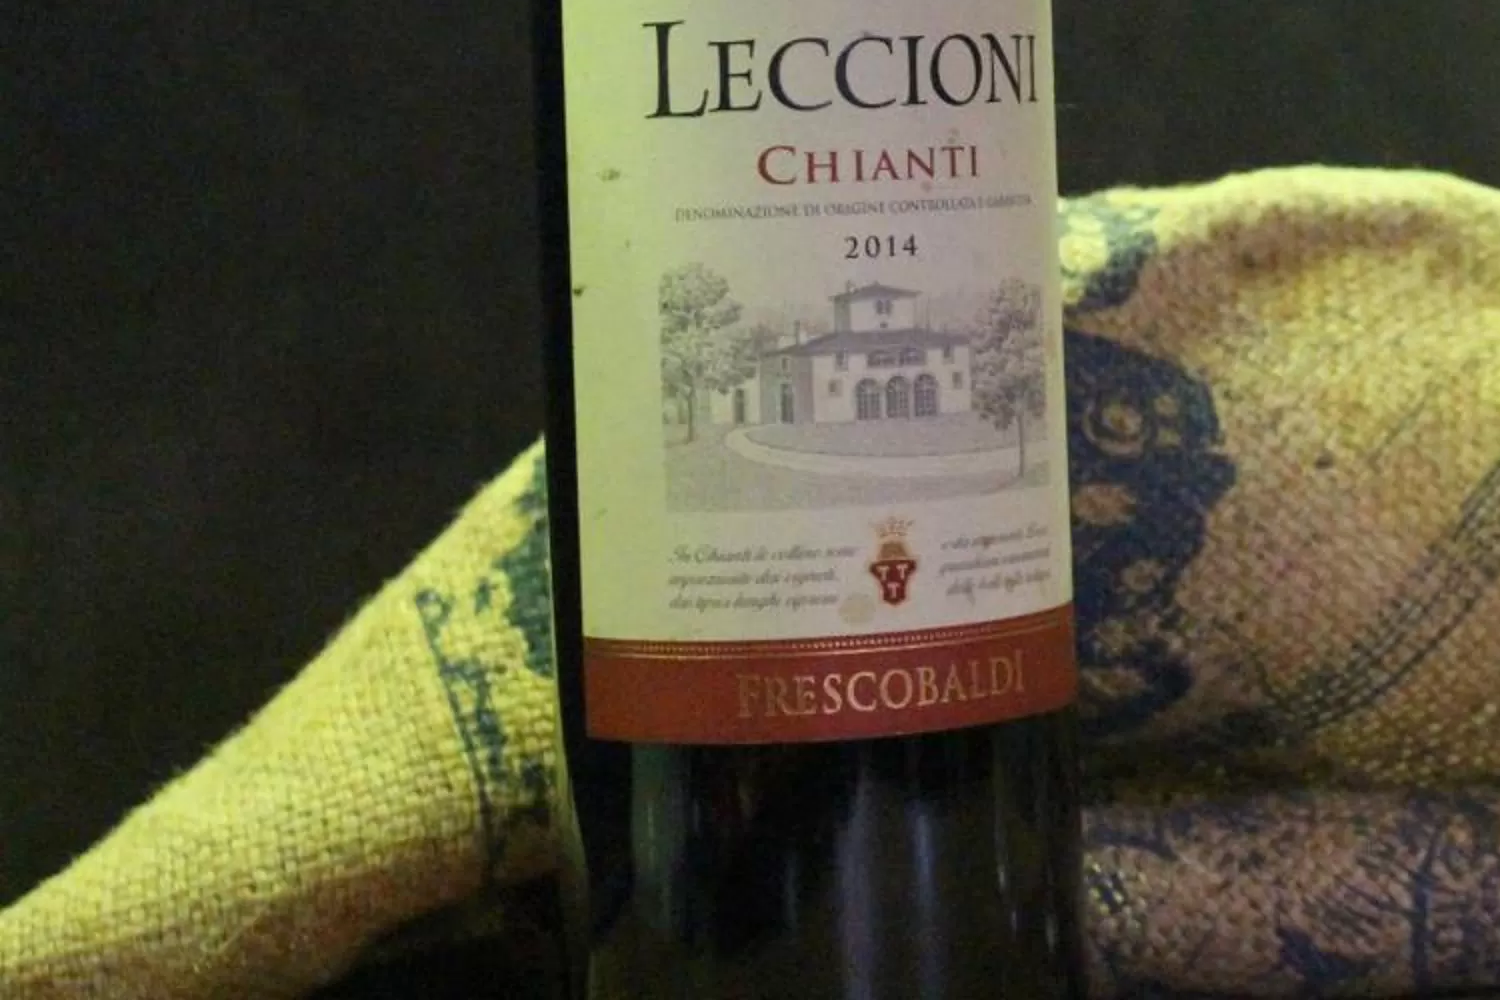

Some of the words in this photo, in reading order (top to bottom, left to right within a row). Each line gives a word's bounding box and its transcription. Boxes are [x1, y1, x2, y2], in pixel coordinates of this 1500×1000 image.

[757, 144, 979, 186] CHIANTI
[843, 233, 919, 261] 2014
[735, 649, 1025, 718] FRESCOBALDI
